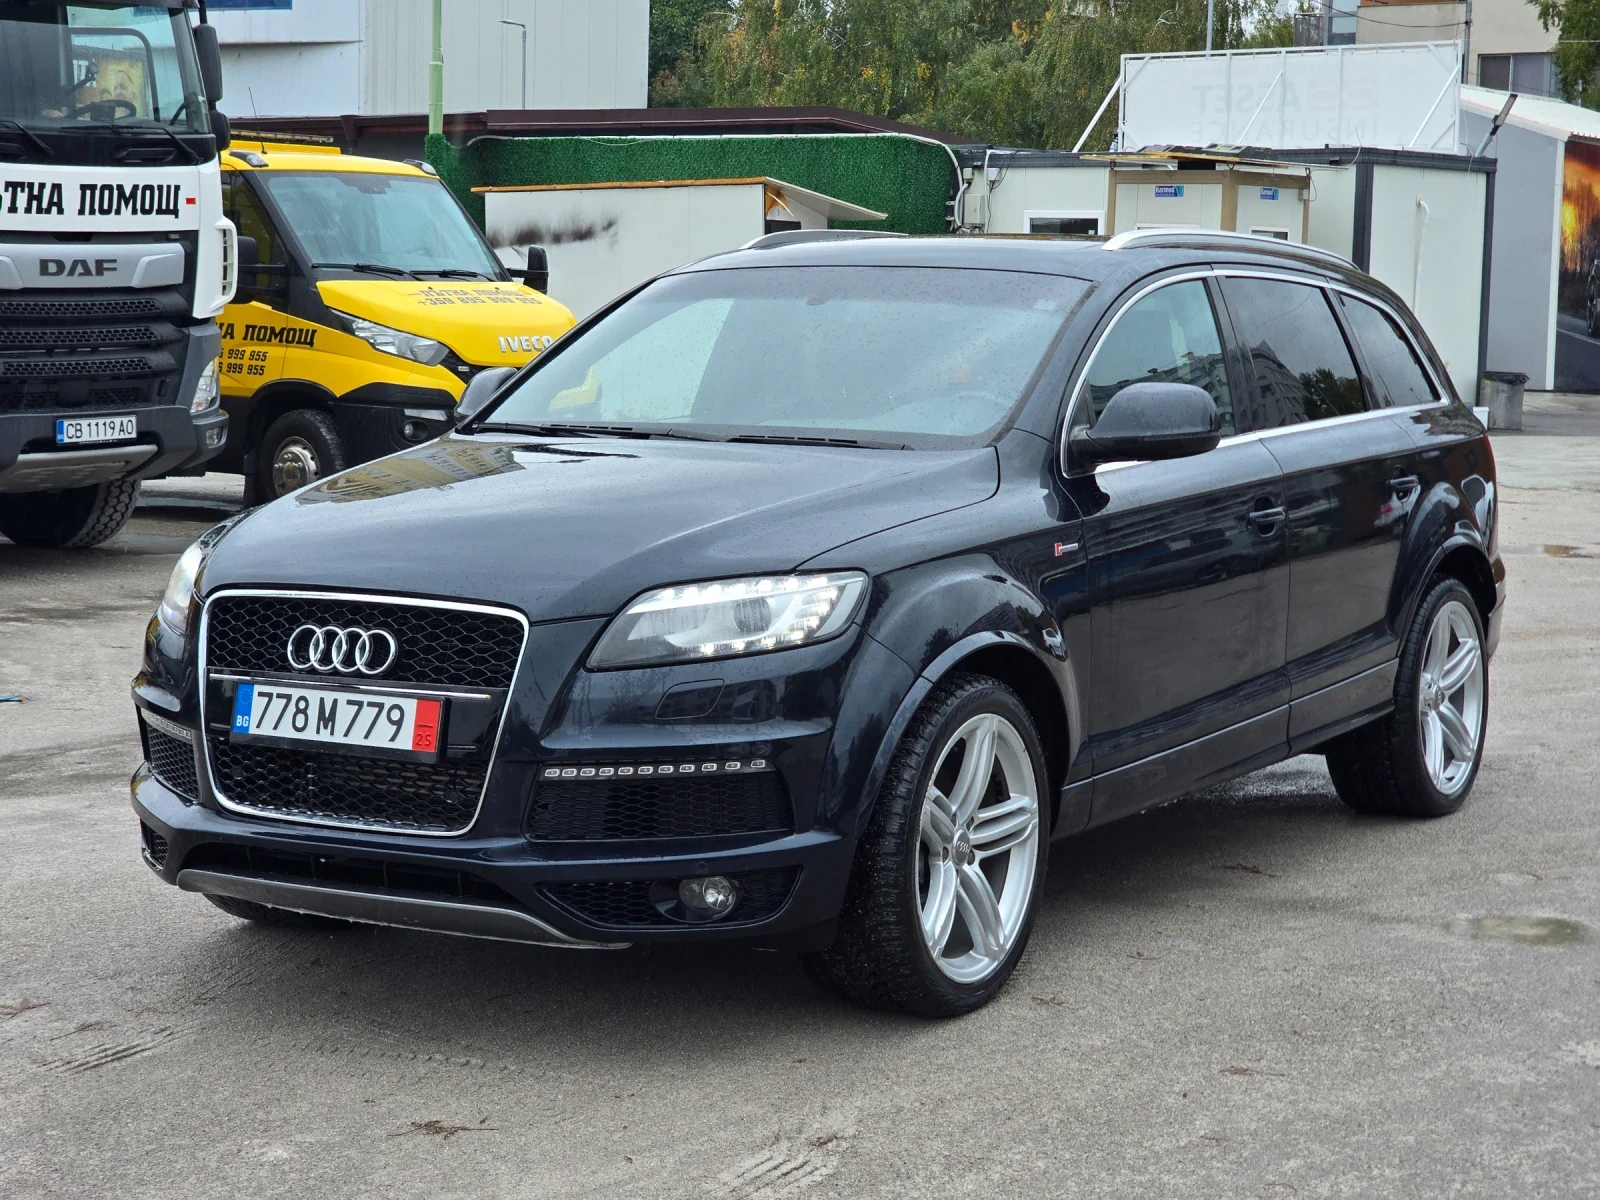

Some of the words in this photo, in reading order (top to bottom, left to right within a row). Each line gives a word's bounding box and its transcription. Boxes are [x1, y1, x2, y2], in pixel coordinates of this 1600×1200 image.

[0, 181, 65, 215] ТНА
[78, 183, 181, 219] ПОМОЩ
[39, 259, 118, 277] DAF
[242, 324, 317, 347] ПОМОЩ
[498, 335, 553, 353] IVECO
[228, 348, 246, 360] 999
[249, 350, 269, 362] 955
[226, 362, 244, 374] 999
[247, 364, 266, 376] 955
[236, 714, 249, 728] BG
[415, 733, 432, 747] 25
